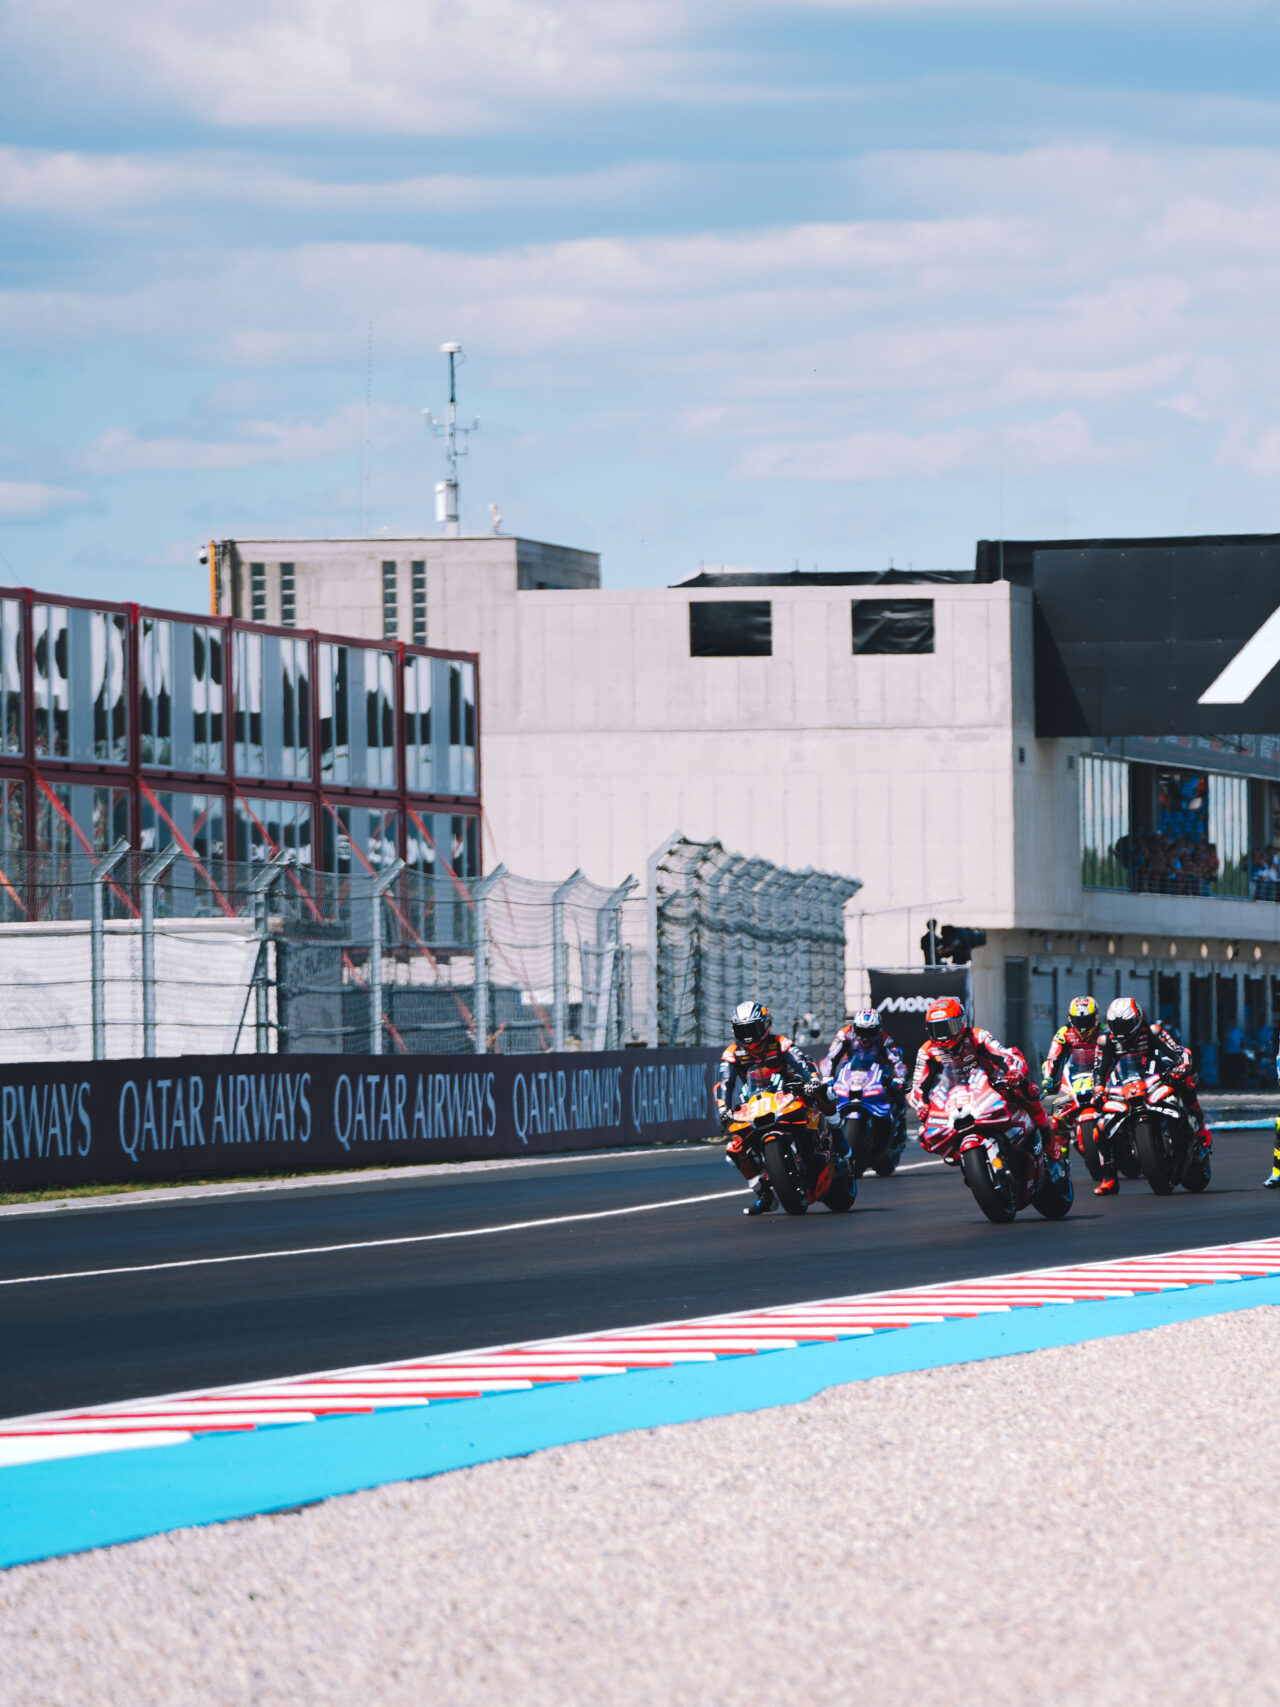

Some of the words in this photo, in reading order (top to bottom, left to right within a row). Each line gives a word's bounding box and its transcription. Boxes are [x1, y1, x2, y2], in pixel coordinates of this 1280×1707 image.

[2, 1081, 92, 1161] RWAYS
[118, 1075, 206, 1162] QATAR
[211, 1072, 312, 1144] AIRWAYS
[333, 1073, 408, 1151] QATAR
[412, 1071, 497, 1138] AIRWAYS
[512, 1070, 568, 1144] QATAR
[569, 1066, 622, 1130] AIRWAYS
[632, 1065, 667, 1133] QATAR
[668, 1063, 708, 1121] AIRWAYS
[749, 1097, 772, 1118] 37
